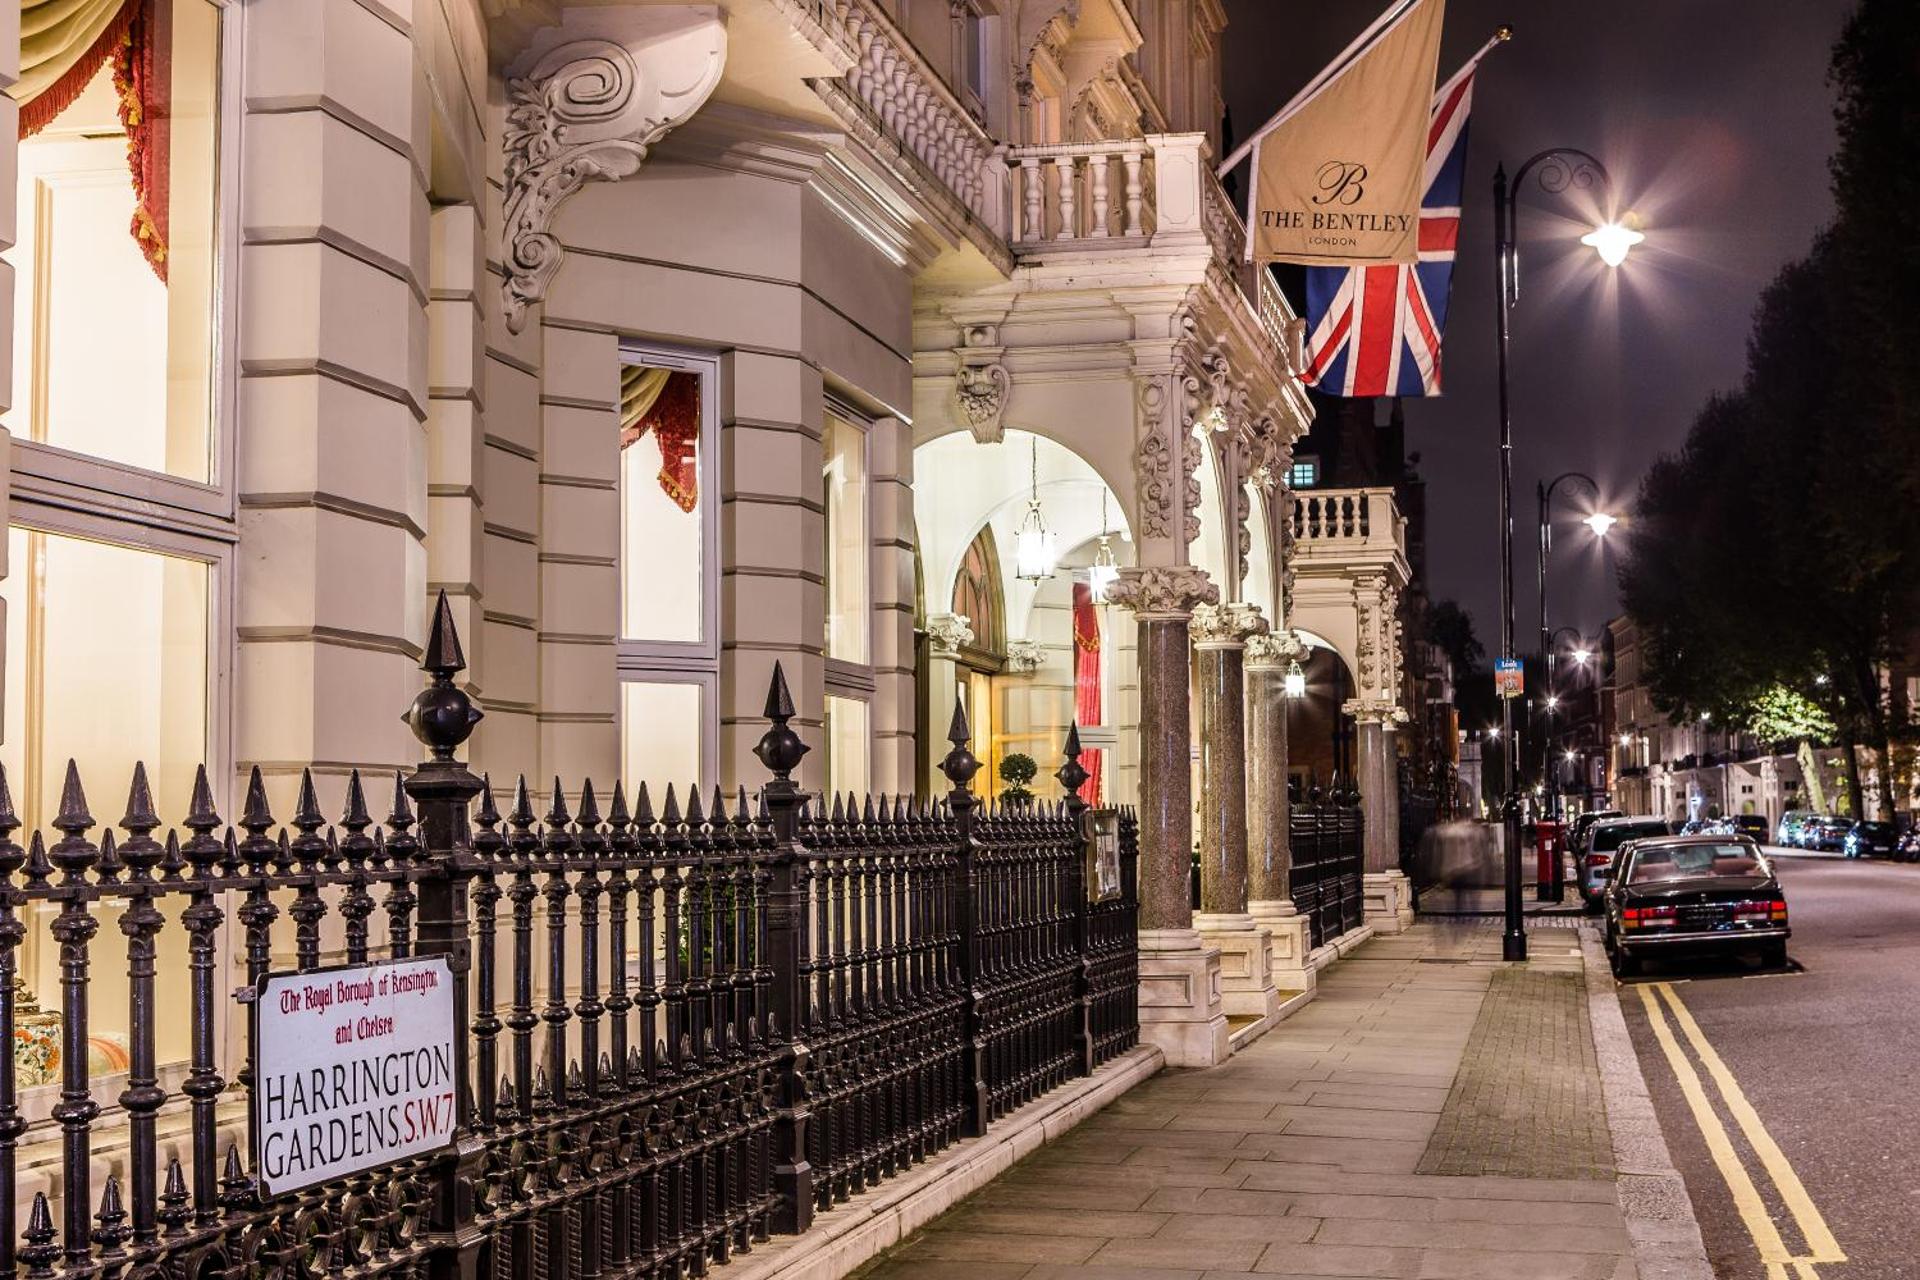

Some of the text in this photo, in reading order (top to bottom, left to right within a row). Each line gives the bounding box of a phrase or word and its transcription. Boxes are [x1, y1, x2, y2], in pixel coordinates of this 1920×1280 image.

[1261, 210, 1411, 233] THE BENTLEY
[1308, 236, 1357, 246] LONDON
[280, 969, 438, 1015] The Royal Borough of Kensington
[335, 1014, 394, 1045] and Chelsea
[266, 1042, 450, 1124] HARRINGTON
